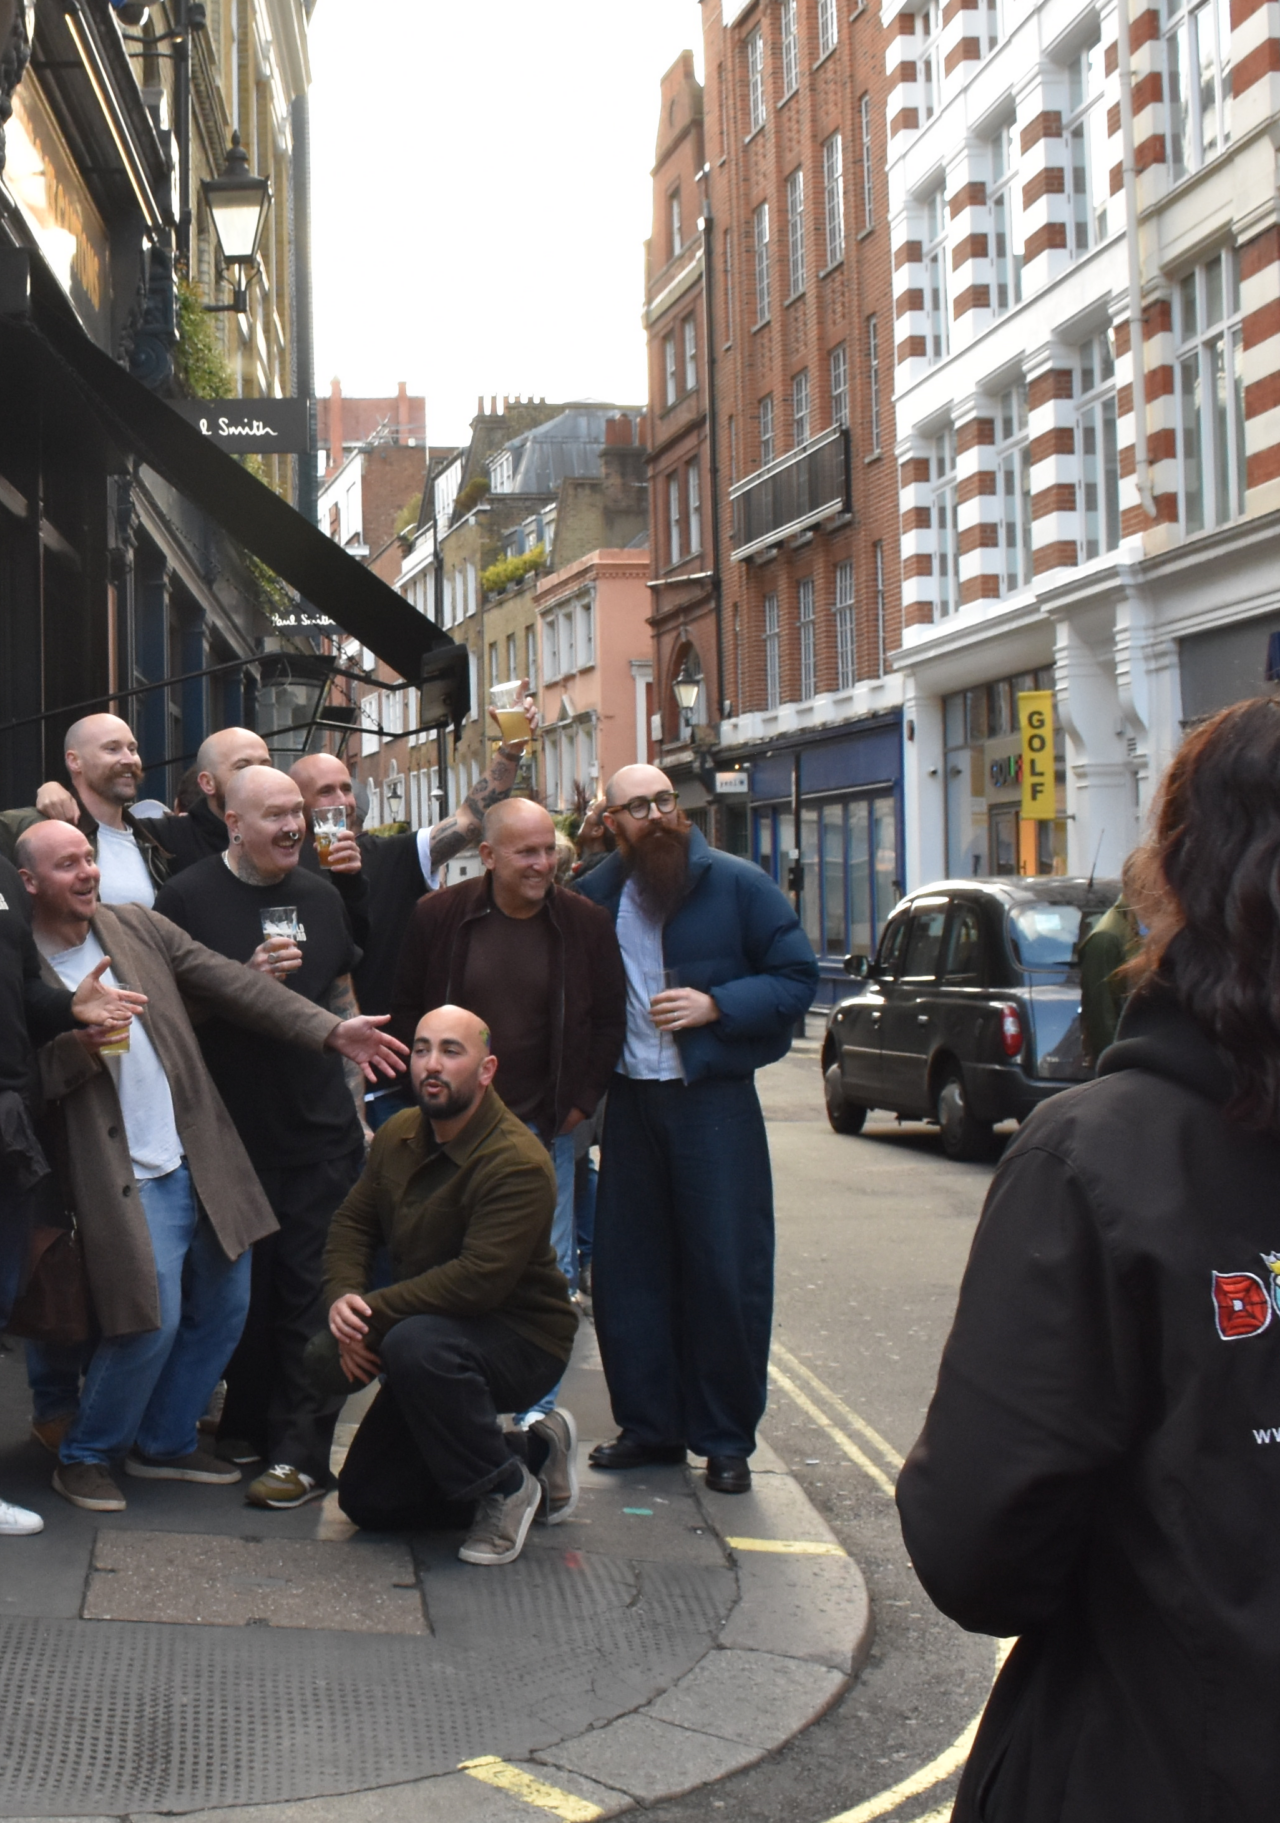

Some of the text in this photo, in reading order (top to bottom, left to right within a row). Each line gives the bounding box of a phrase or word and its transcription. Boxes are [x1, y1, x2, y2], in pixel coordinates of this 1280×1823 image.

[218, 417, 279, 436] Smith
[271, 613, 337, 627] Paul Smith
[1027, 710, 1045, 801] GOLF
